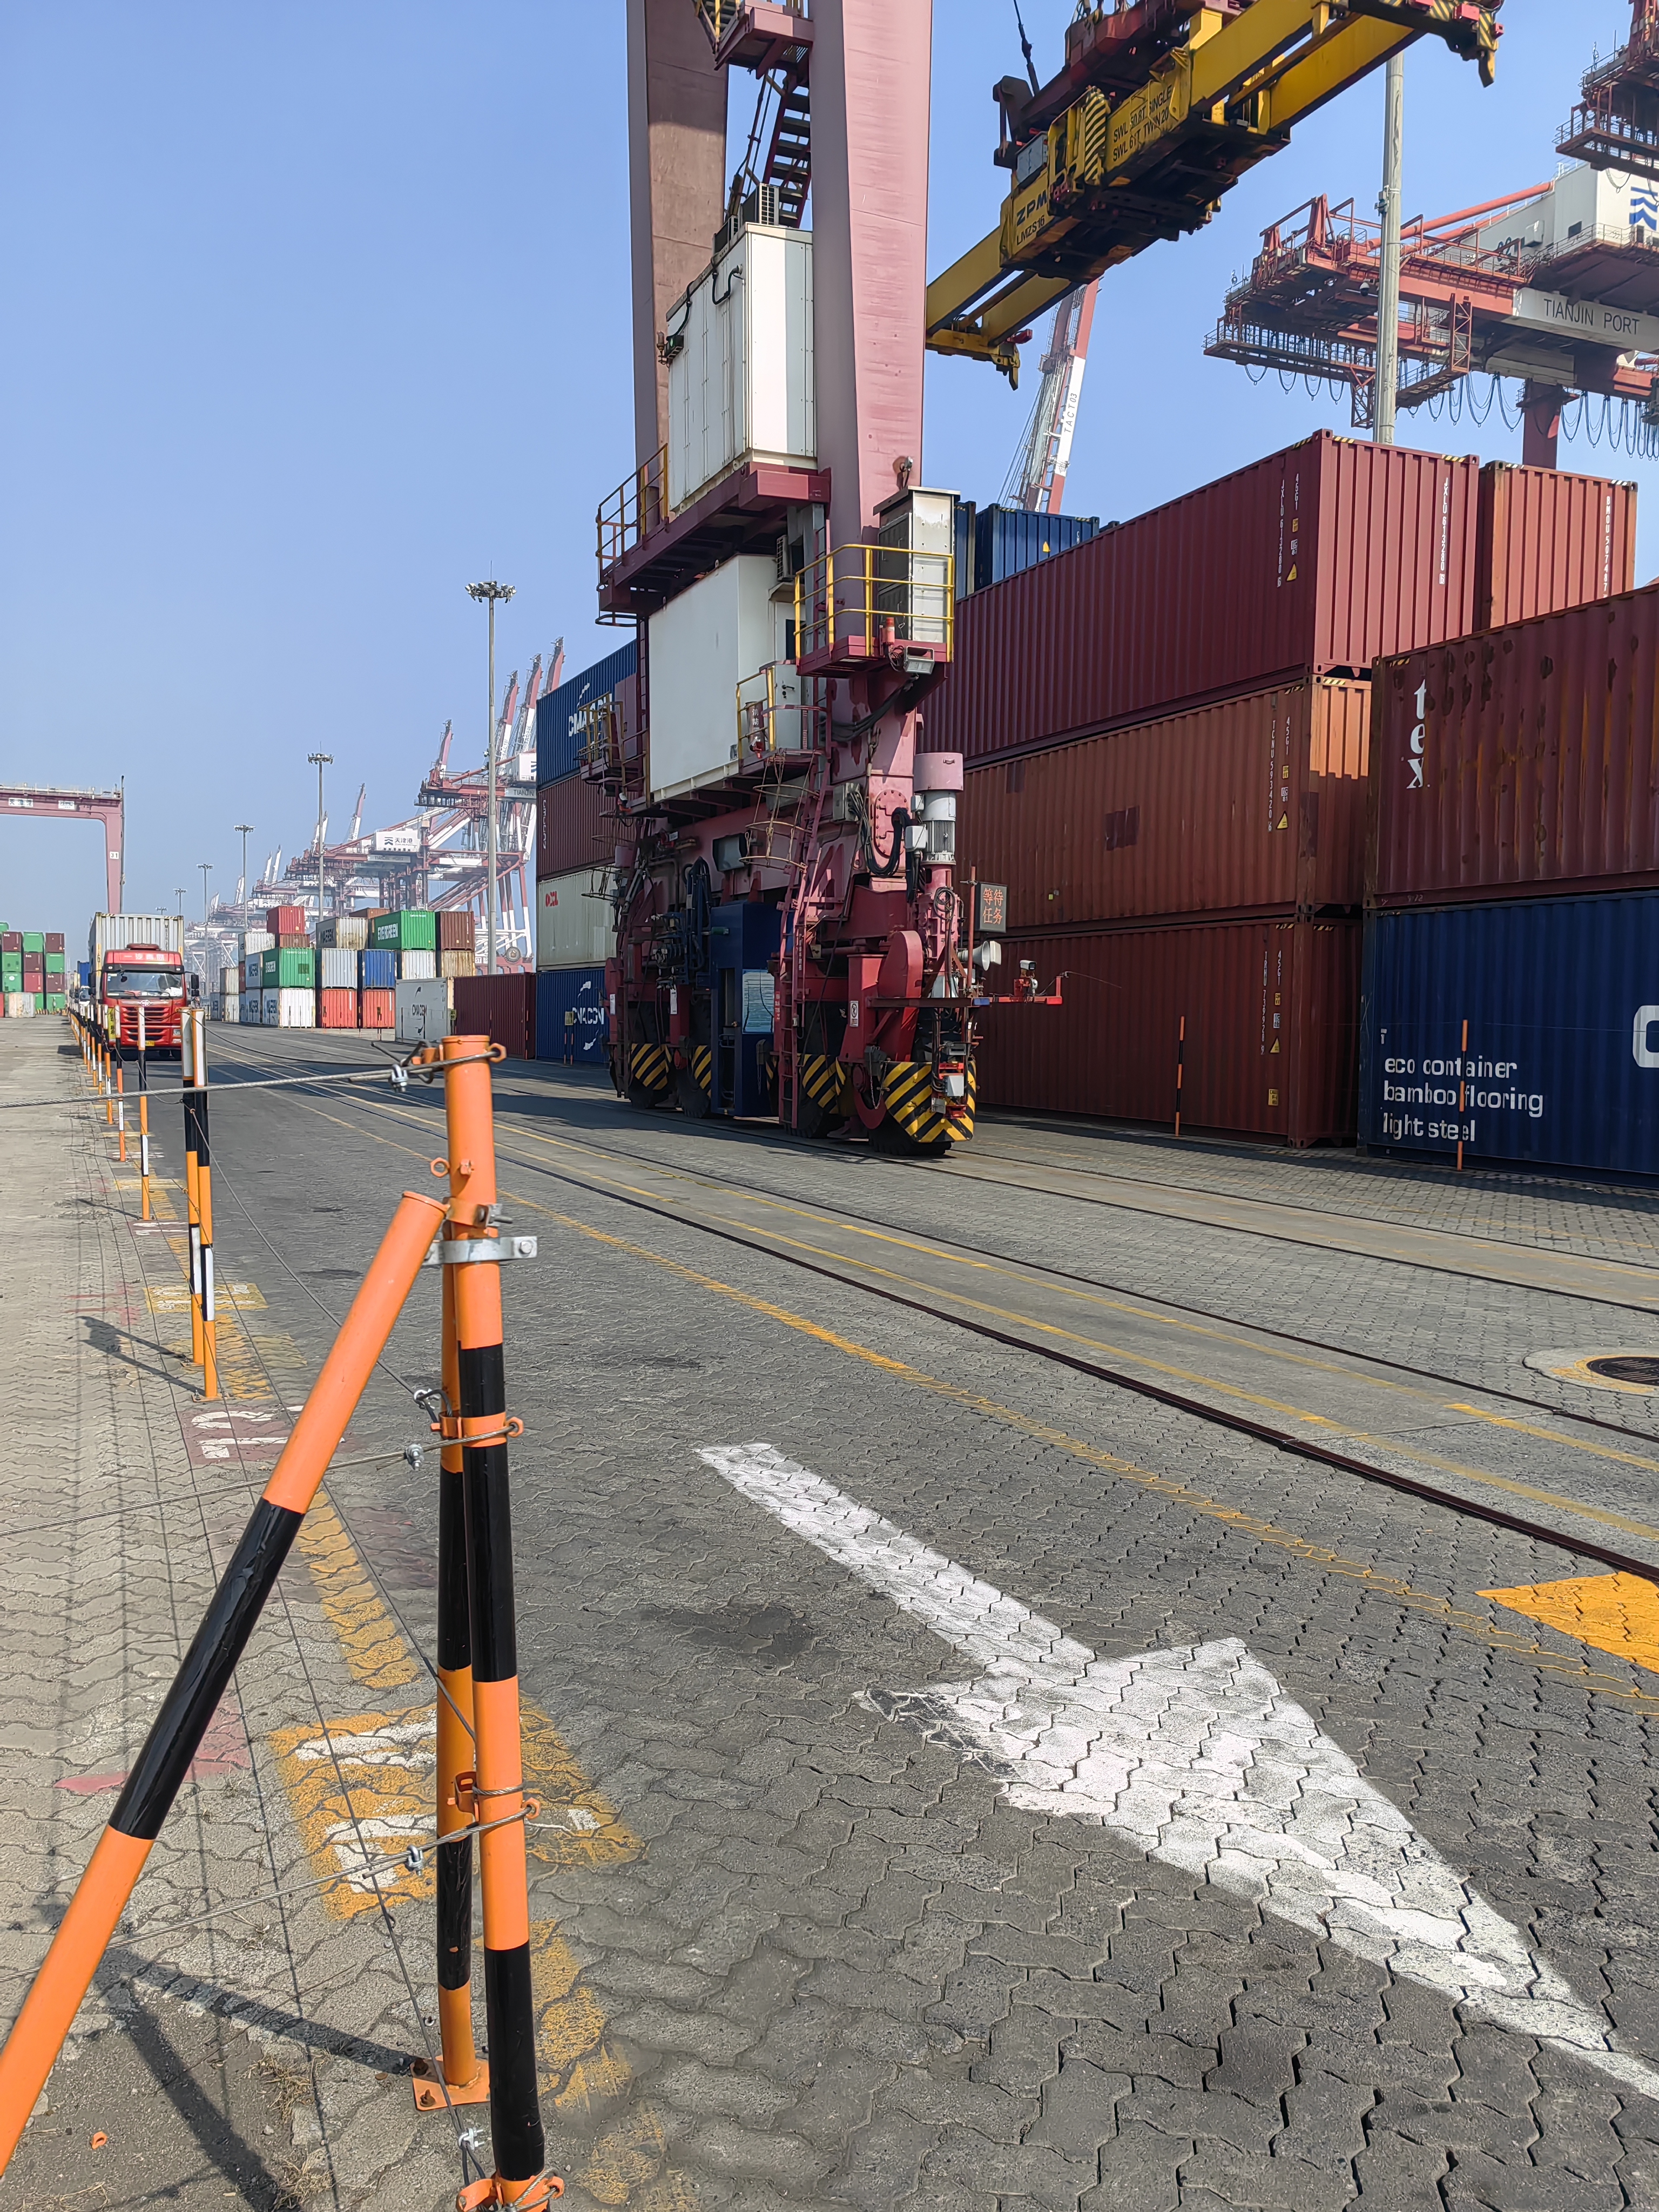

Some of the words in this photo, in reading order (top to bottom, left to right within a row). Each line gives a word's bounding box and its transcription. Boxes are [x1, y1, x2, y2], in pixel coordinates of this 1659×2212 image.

[1114, 122, 1128, 143] SWL
[1113, 141, 1128, 161] SWL
[1543, 298, 1593, 326] TIANJIN
[1604, 312, 1640, 335] PORT
[983, 887, 1003, 907] 等待
[982, 905, 1002, 925] 任务
[1385, 1058, 1415, 1074] eco
[1423, 1055, 1518, 1078] container
[1384, 1080, 1456, 1105] bamboo
[1465, 1085, 1543, 1117] flooring
[1383, 1112, 1424, 1140] light
[1428, 1120, 1475, 1142] steel
